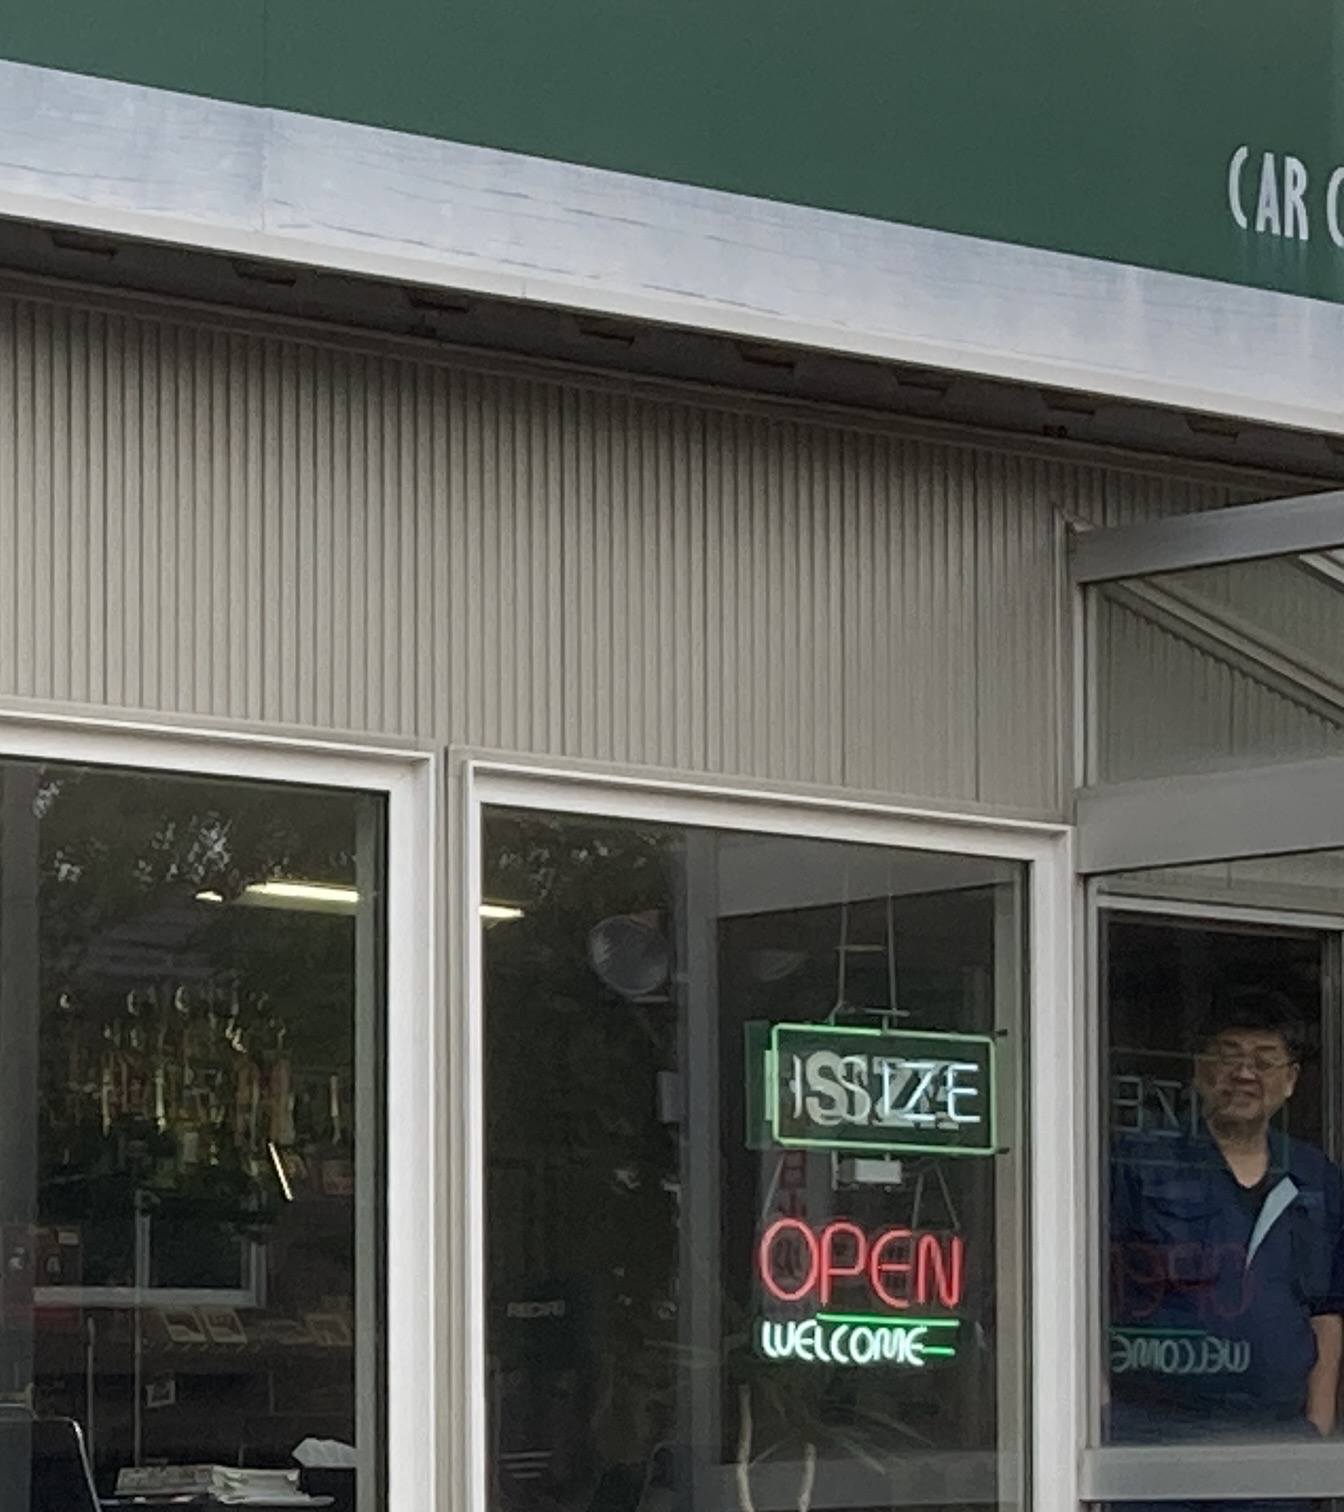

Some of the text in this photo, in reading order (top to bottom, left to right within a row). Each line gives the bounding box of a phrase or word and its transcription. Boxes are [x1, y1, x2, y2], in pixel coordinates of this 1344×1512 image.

[1228, 145, 1309, 241] CAR
[758, 1217, 965, 1309] OPEN
[761, 1319, 928, 1366] WELCOME
